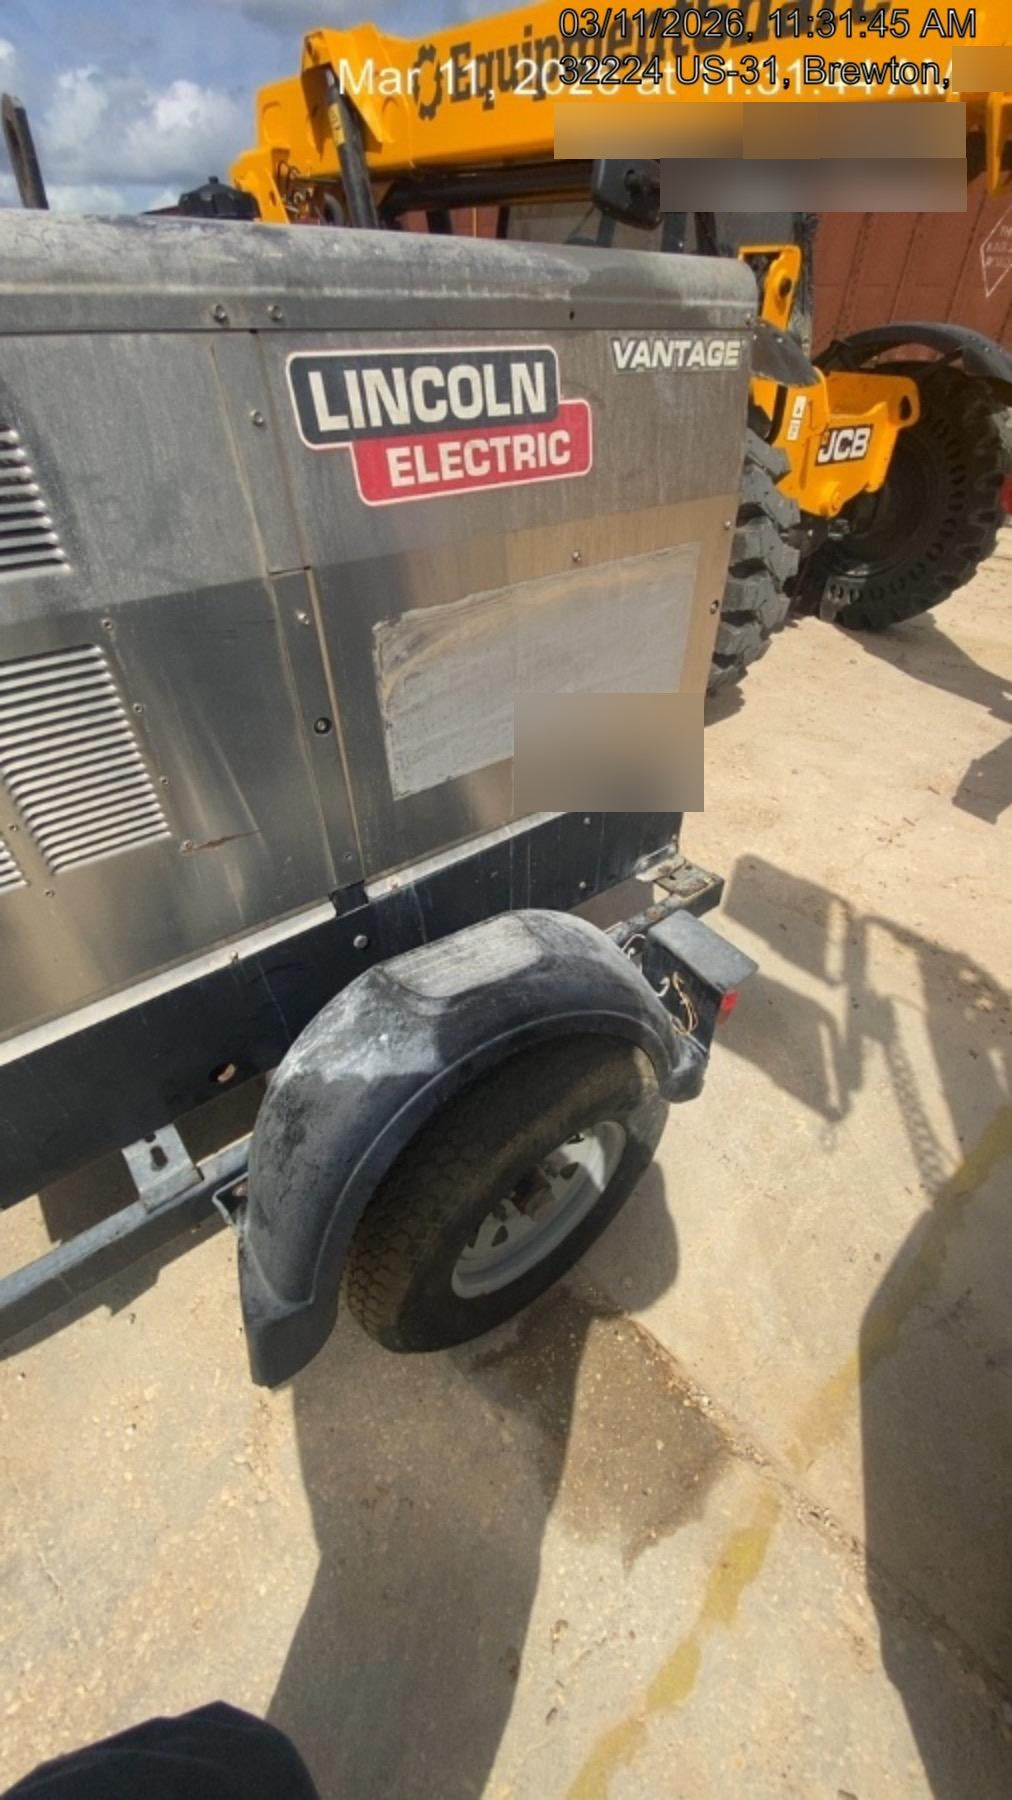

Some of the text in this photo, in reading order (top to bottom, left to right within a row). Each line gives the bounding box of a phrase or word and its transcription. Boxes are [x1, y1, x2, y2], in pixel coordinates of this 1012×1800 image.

[612, 338, 741, 370] VANTAGE
[307, 361, 547, 432] LINCOLN
[385, 429, 572, 488] ELECTRIC
[817, 427, 871, 463] JCB
